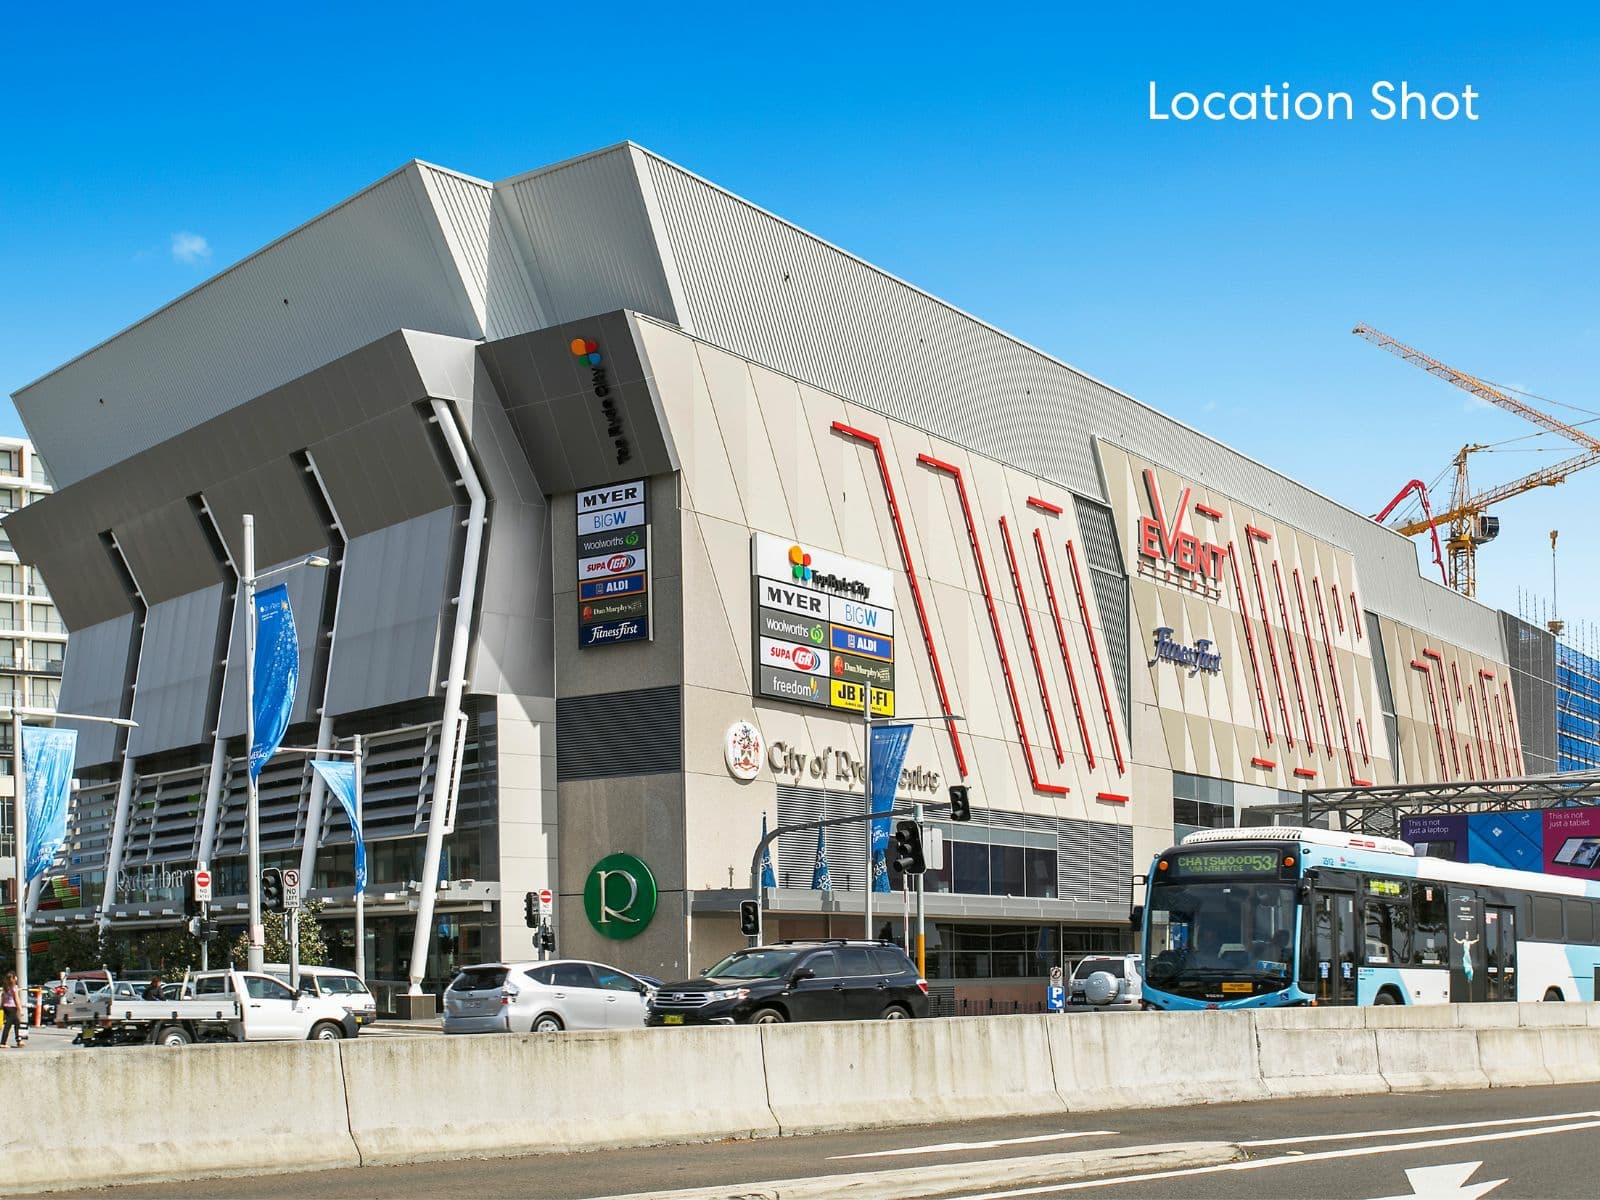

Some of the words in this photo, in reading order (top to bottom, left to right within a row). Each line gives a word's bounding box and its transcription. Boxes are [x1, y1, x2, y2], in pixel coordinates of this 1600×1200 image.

[583, 487, 638, 508] MYER
[1140, 468, 1228, 583] EVENT
[586, 561, 606, 573] SUPA
[609, 557, 627, 570] IGA
[606, 579, 629, 593] ALDI
[767, 586, 822, 613] MYER
[593, 608, 606, 616] Dan
[856, 637, 878, 652] ALDI
[770, 646, 791, 661] SUPA
[794, 652, 812, 666] IGA
[844, 660, 857, 672] Dan
[773, 676, 812, 697] freedom
[838, 684, 856, 700] JB
[767, 741, 807, 785] City
[810, 746, 832, 779] of
[898, 765, 941, 794] entre
[1570, 811, 1584, 819] not
[1408, 827, 1421, 835] just
[1427, 826, 1449, 834] laptop
[1548, 819, 1562, 829] just
[1569, 818, 1591, 827] tablet
[1177, 855, 1253, 867] CHATSWOOD
[597, 869, 641, 923] R
[1052, 988, 1063, 998] P
